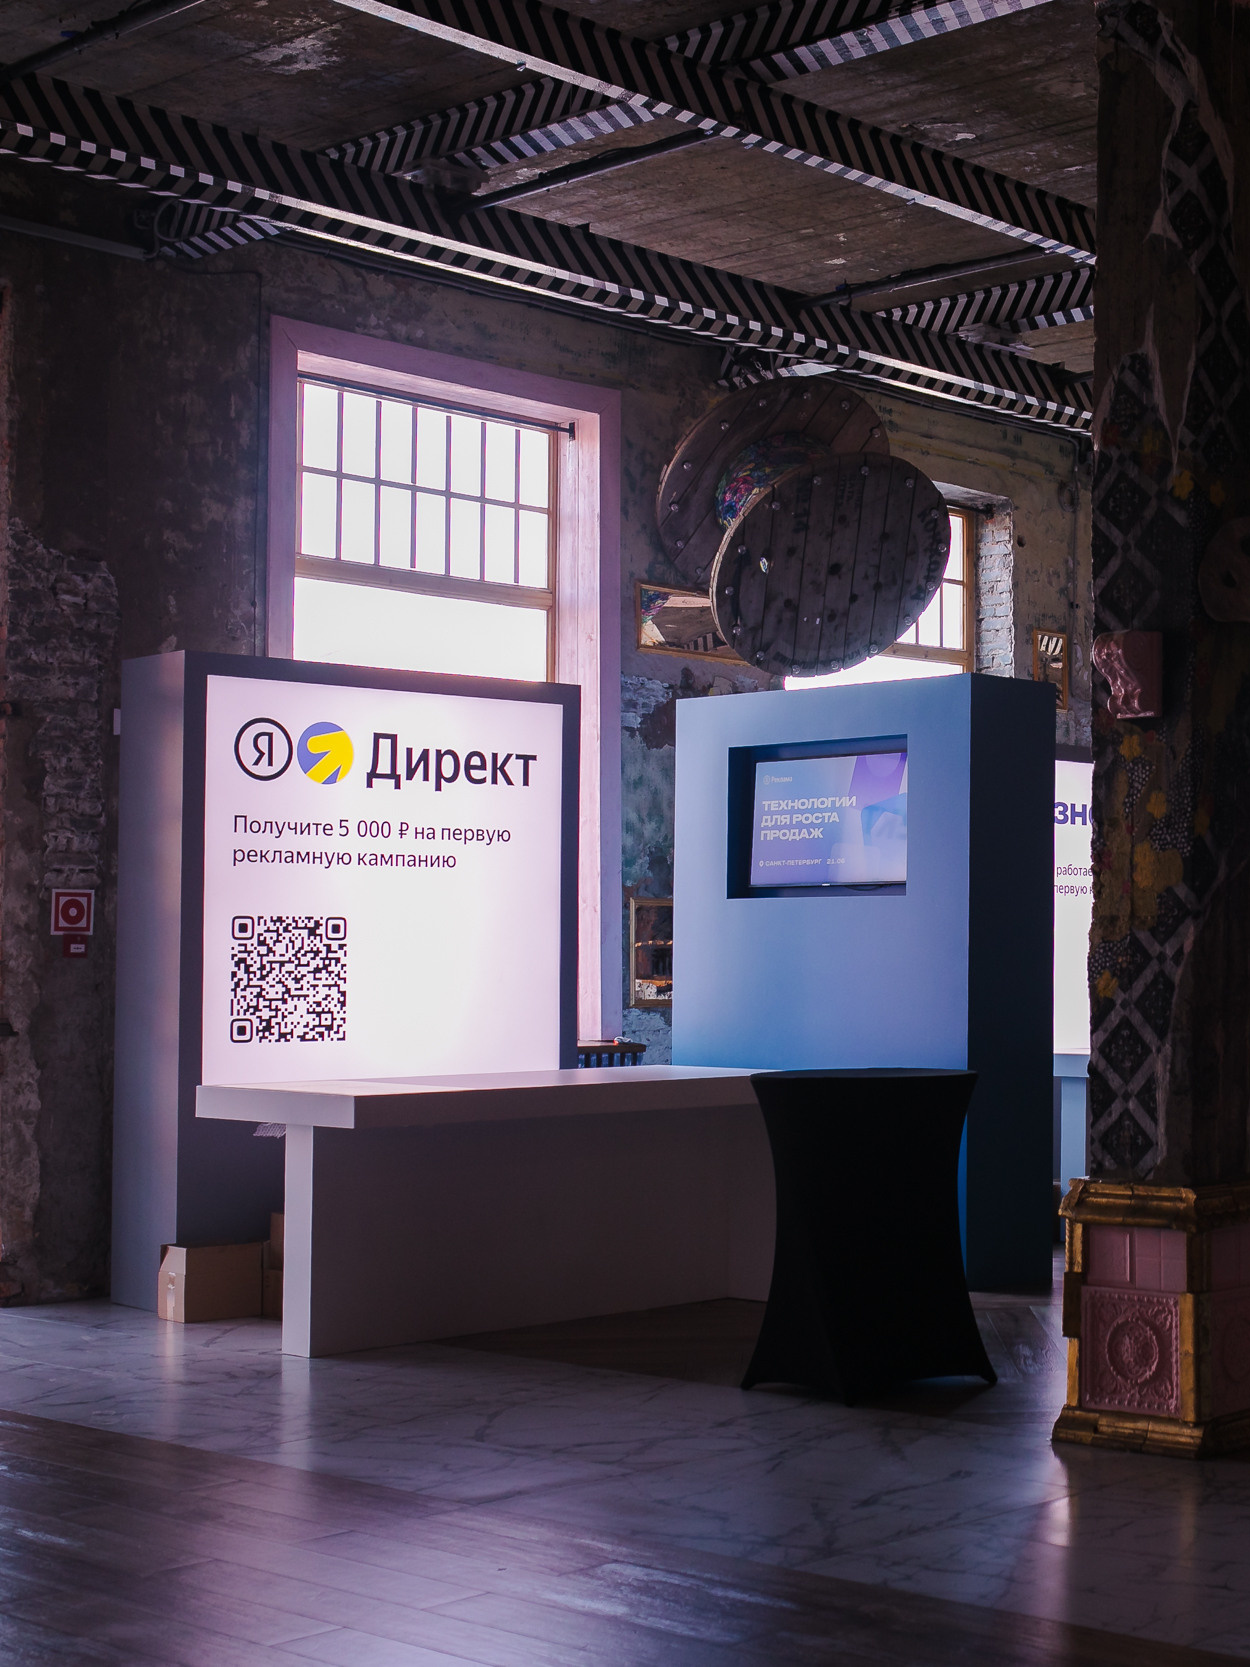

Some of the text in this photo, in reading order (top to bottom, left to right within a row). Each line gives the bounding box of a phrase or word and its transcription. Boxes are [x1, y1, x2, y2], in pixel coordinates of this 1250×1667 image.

[366, 732, 538, 792] Директ
[762, 796, 857, 811] ТЕХНОЛОГИИ
[761, 812, 840, 828] ДЛЯ РОСТА
[1055, 802, 1092, 825] ЗН
[233, 815, 511, 845] Получите 5 000 ₽ на первую
[760, 828, 824, 842] ПРОДАЖ
[232, 846, 457, 869] рекламную кампанию
[765, 859, 822, 867] САНКТ-ПЕТЕРБУРГ
